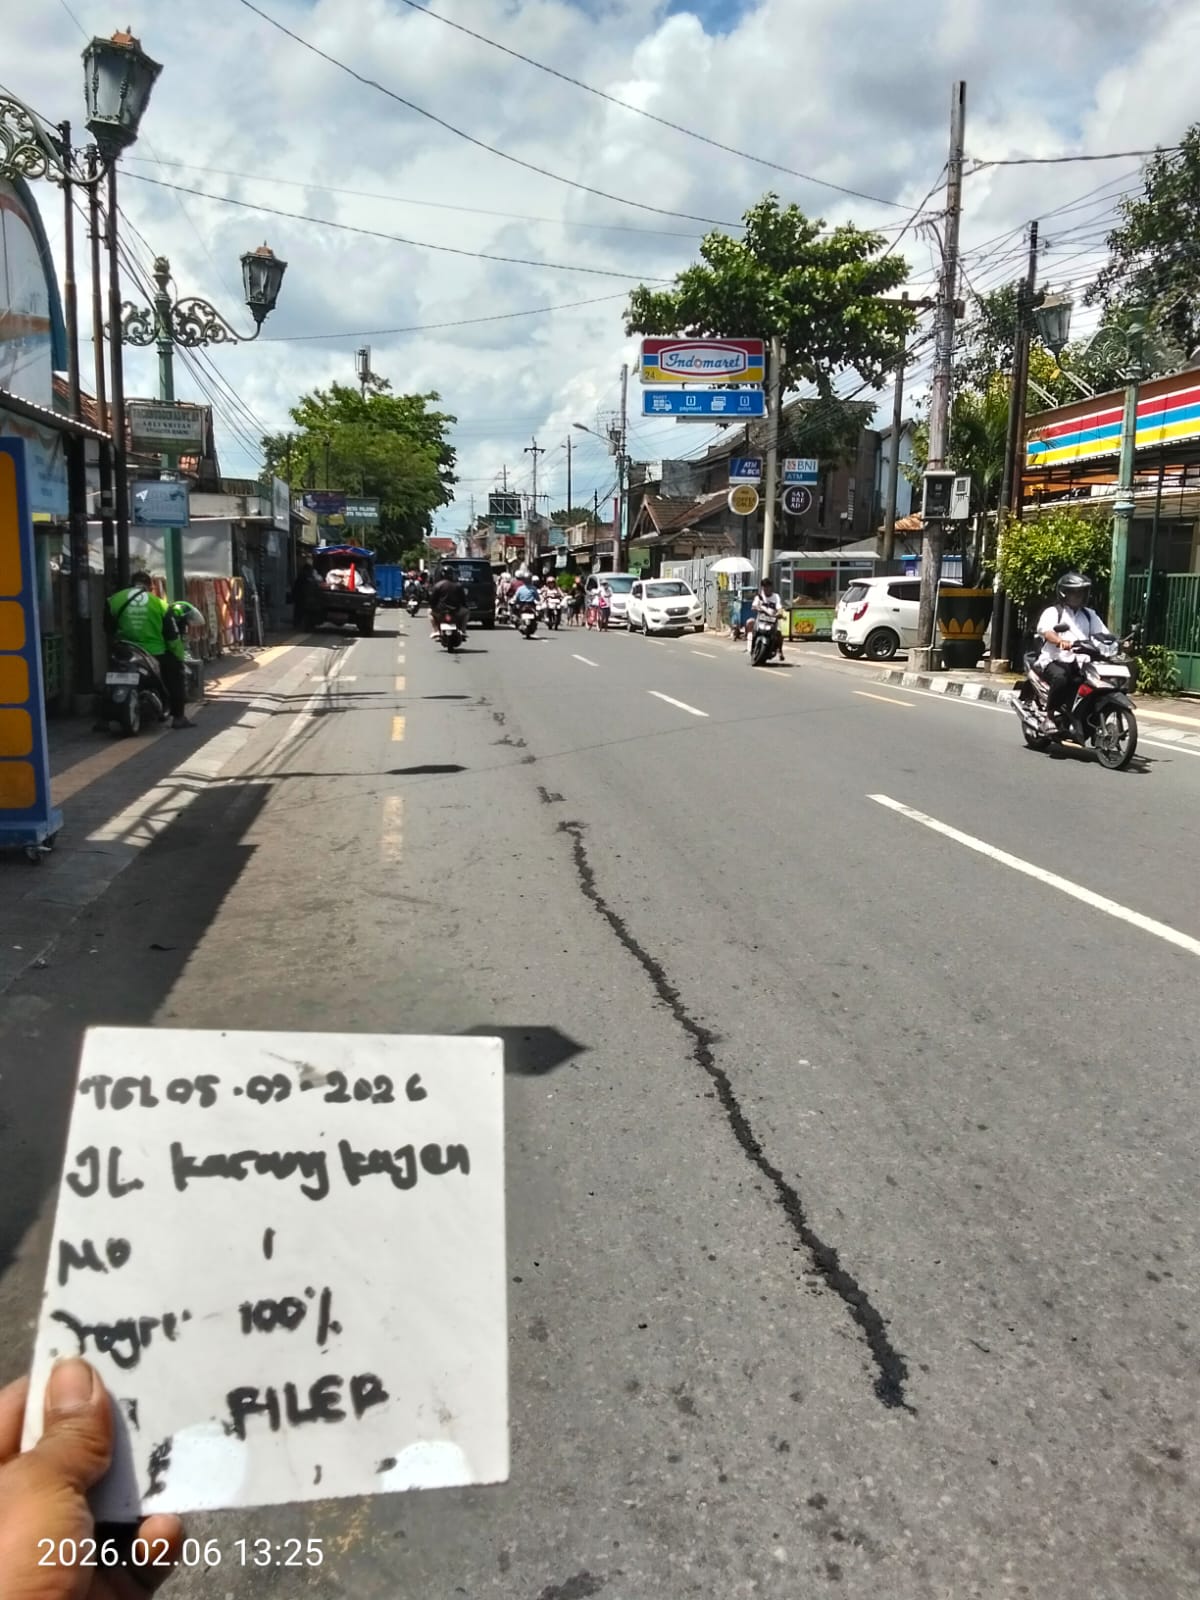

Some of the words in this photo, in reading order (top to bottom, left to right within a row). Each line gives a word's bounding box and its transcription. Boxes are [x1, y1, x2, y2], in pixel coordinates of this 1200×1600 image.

[665, 353, 740, 369] Indomaret
[645, 371, 655, 380] 24
[797, 461, 816, 471] BNI
[238, 1286, 343, 1347] 100%
